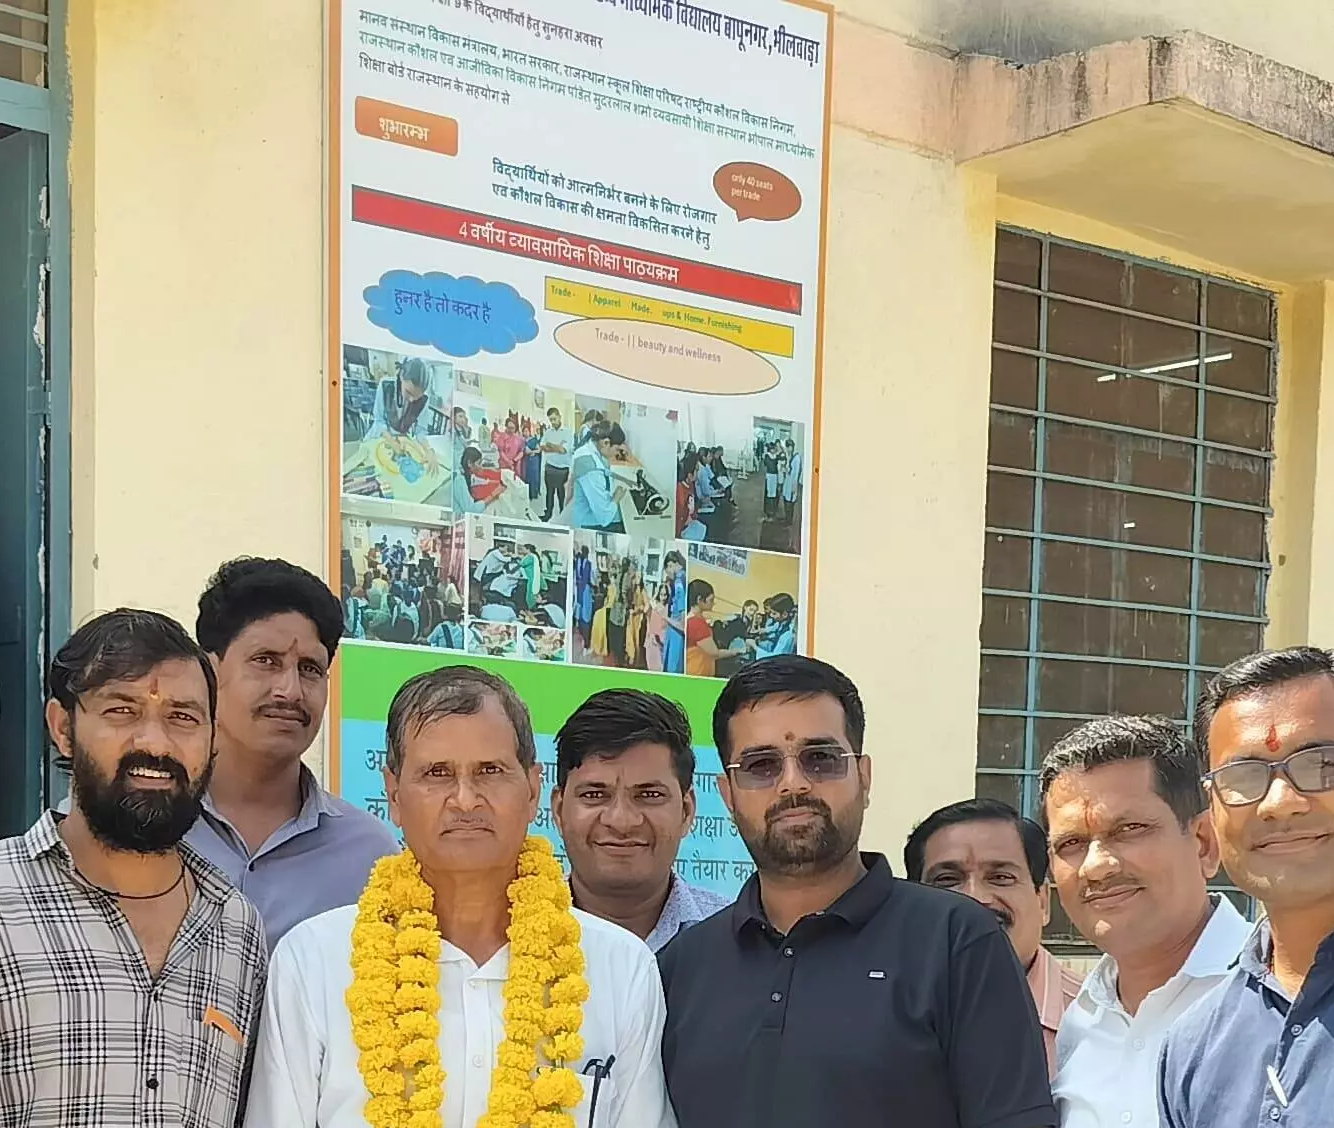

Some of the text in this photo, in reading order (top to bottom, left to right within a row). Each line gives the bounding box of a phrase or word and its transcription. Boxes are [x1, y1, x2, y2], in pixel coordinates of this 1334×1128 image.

[526, 14, 541, 38] हेतु
[542, 20, 573, 40] सुनहरा
[574, 29, 603, 49] अवसर
[676, 0, 721, 37] विद्यालय
[358, 51, 386, 73] शिक्षा
[406, 67, 452, 90] राजस्थान
[453, 76, 464, 93] के
[465, 82, 500, 102] सहयोग
[500, 89, 511, 105] से
[359, 9, 388, 28] मानव
[427, 24, 460, 47] विकास
[502, 47, 527, 65] भारत
[564, 64, 605, 86] राजस्थान
[607, 76, 630, 96] स्कूल
[631, 79, 654, 100] शिक्षा
[684, 97, 713, 114] राष्ट्रीय
[713, 103, 740, 120] कौशल
[741, 108, 768, 128] विकास
[359, 30, 406, 53] राजस्थान
[407, 42, 438, 62] कौशल
[457, 56, 504, 80] आजीविका
[505, 66, 537, 88] विकास
[538, 75, 566, 96] निगम
[693, 115, 716, 133] शिक्षा
[378, 116, 430, 142] शुभारम्भ
[550, 171, 566, 190] को
[566, 180, 622, 203] आत्मनिर्भर
[623, 191, 648, 208] बनने
[649, 194, 659, 211] के
[660, 197, 681, 216] लिए
[682, 202, 718, 224] रोजगार
[509, 186, 543, 206] कौशल
[544, 191, 579, 214] विकास
[580, 201, 595, 218] की
[596, 207, 627, 225] क्षमता
[628, 210, 670, 235] विकसित
[670, 224, 694, 241] करने
[695, 227, 711, 250] हेतु
[458, 221, 468, 238] 4
[470, 221, 508, 247] वर्षीय
[508, 231, 587, 263] व्यावसायिक
[587, 243, 621, 271] शिक्षा
[394, 288, 492, 323] हुनर है तो कदर है
[551, 285, 572, 298] Trade
[595, 327, 620, 343] Trade
[637, 336, 667, 355] beauty
[668, 340, 684, 356] and
[685, 345, 721, 363] wellness
[690, 850, 729, 881] तैयार
